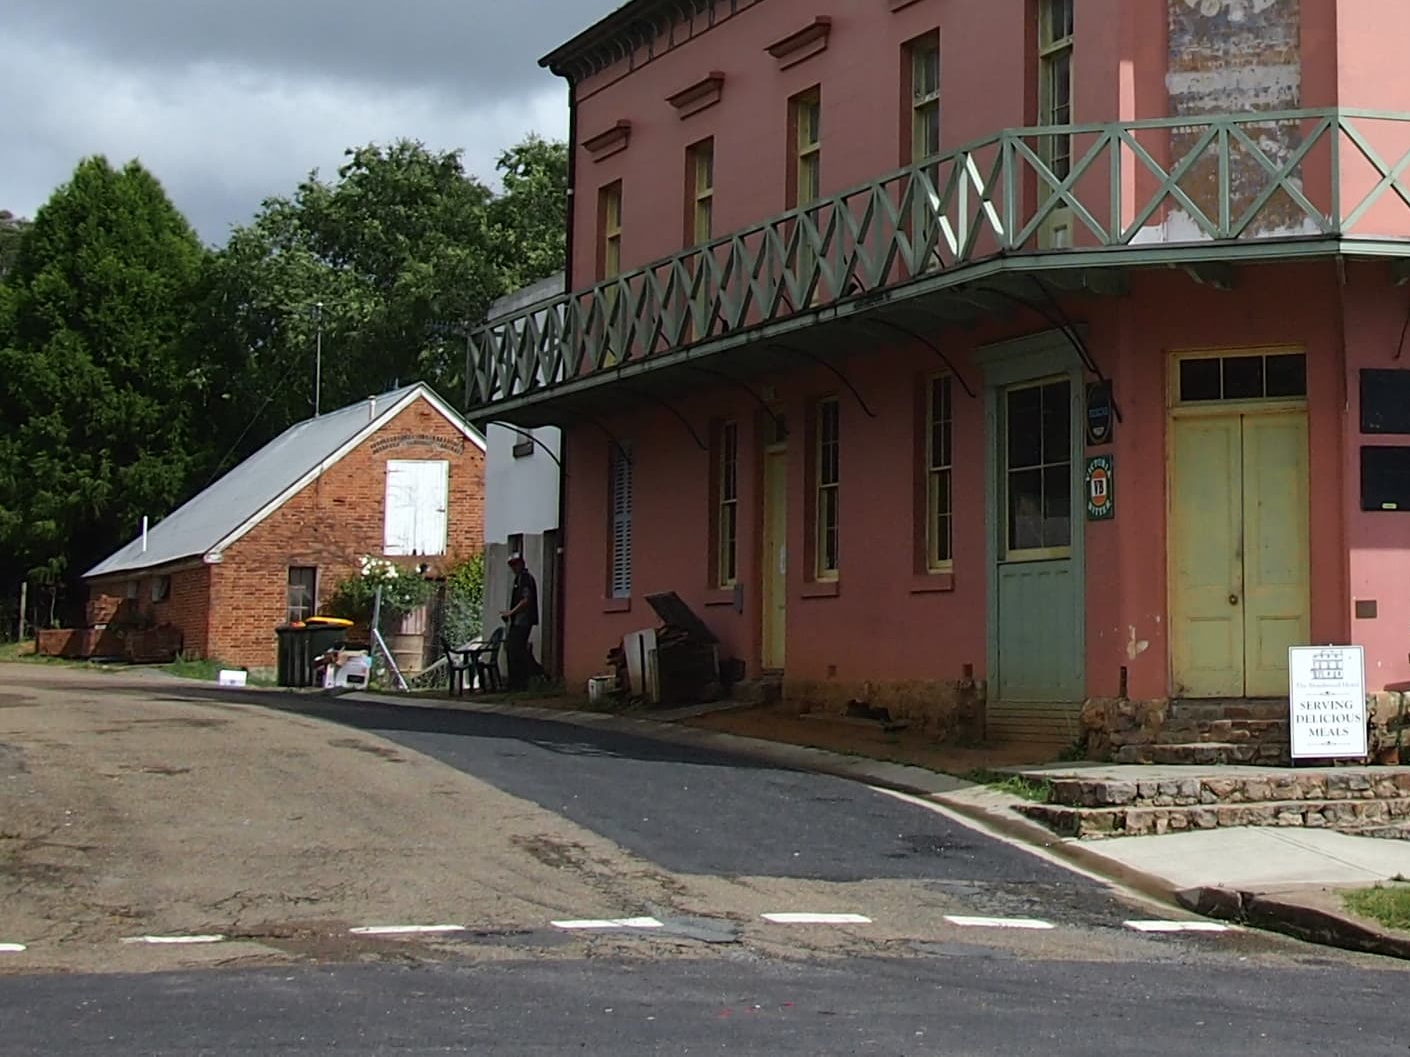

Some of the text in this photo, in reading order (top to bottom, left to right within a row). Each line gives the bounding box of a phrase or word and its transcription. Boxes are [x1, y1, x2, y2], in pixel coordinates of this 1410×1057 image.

[1299, 700, 1354, 711] SERVING
[1295, 713, 1362, 724] DELICIOUS
[1308, 726, 1350, 738] MEALS
